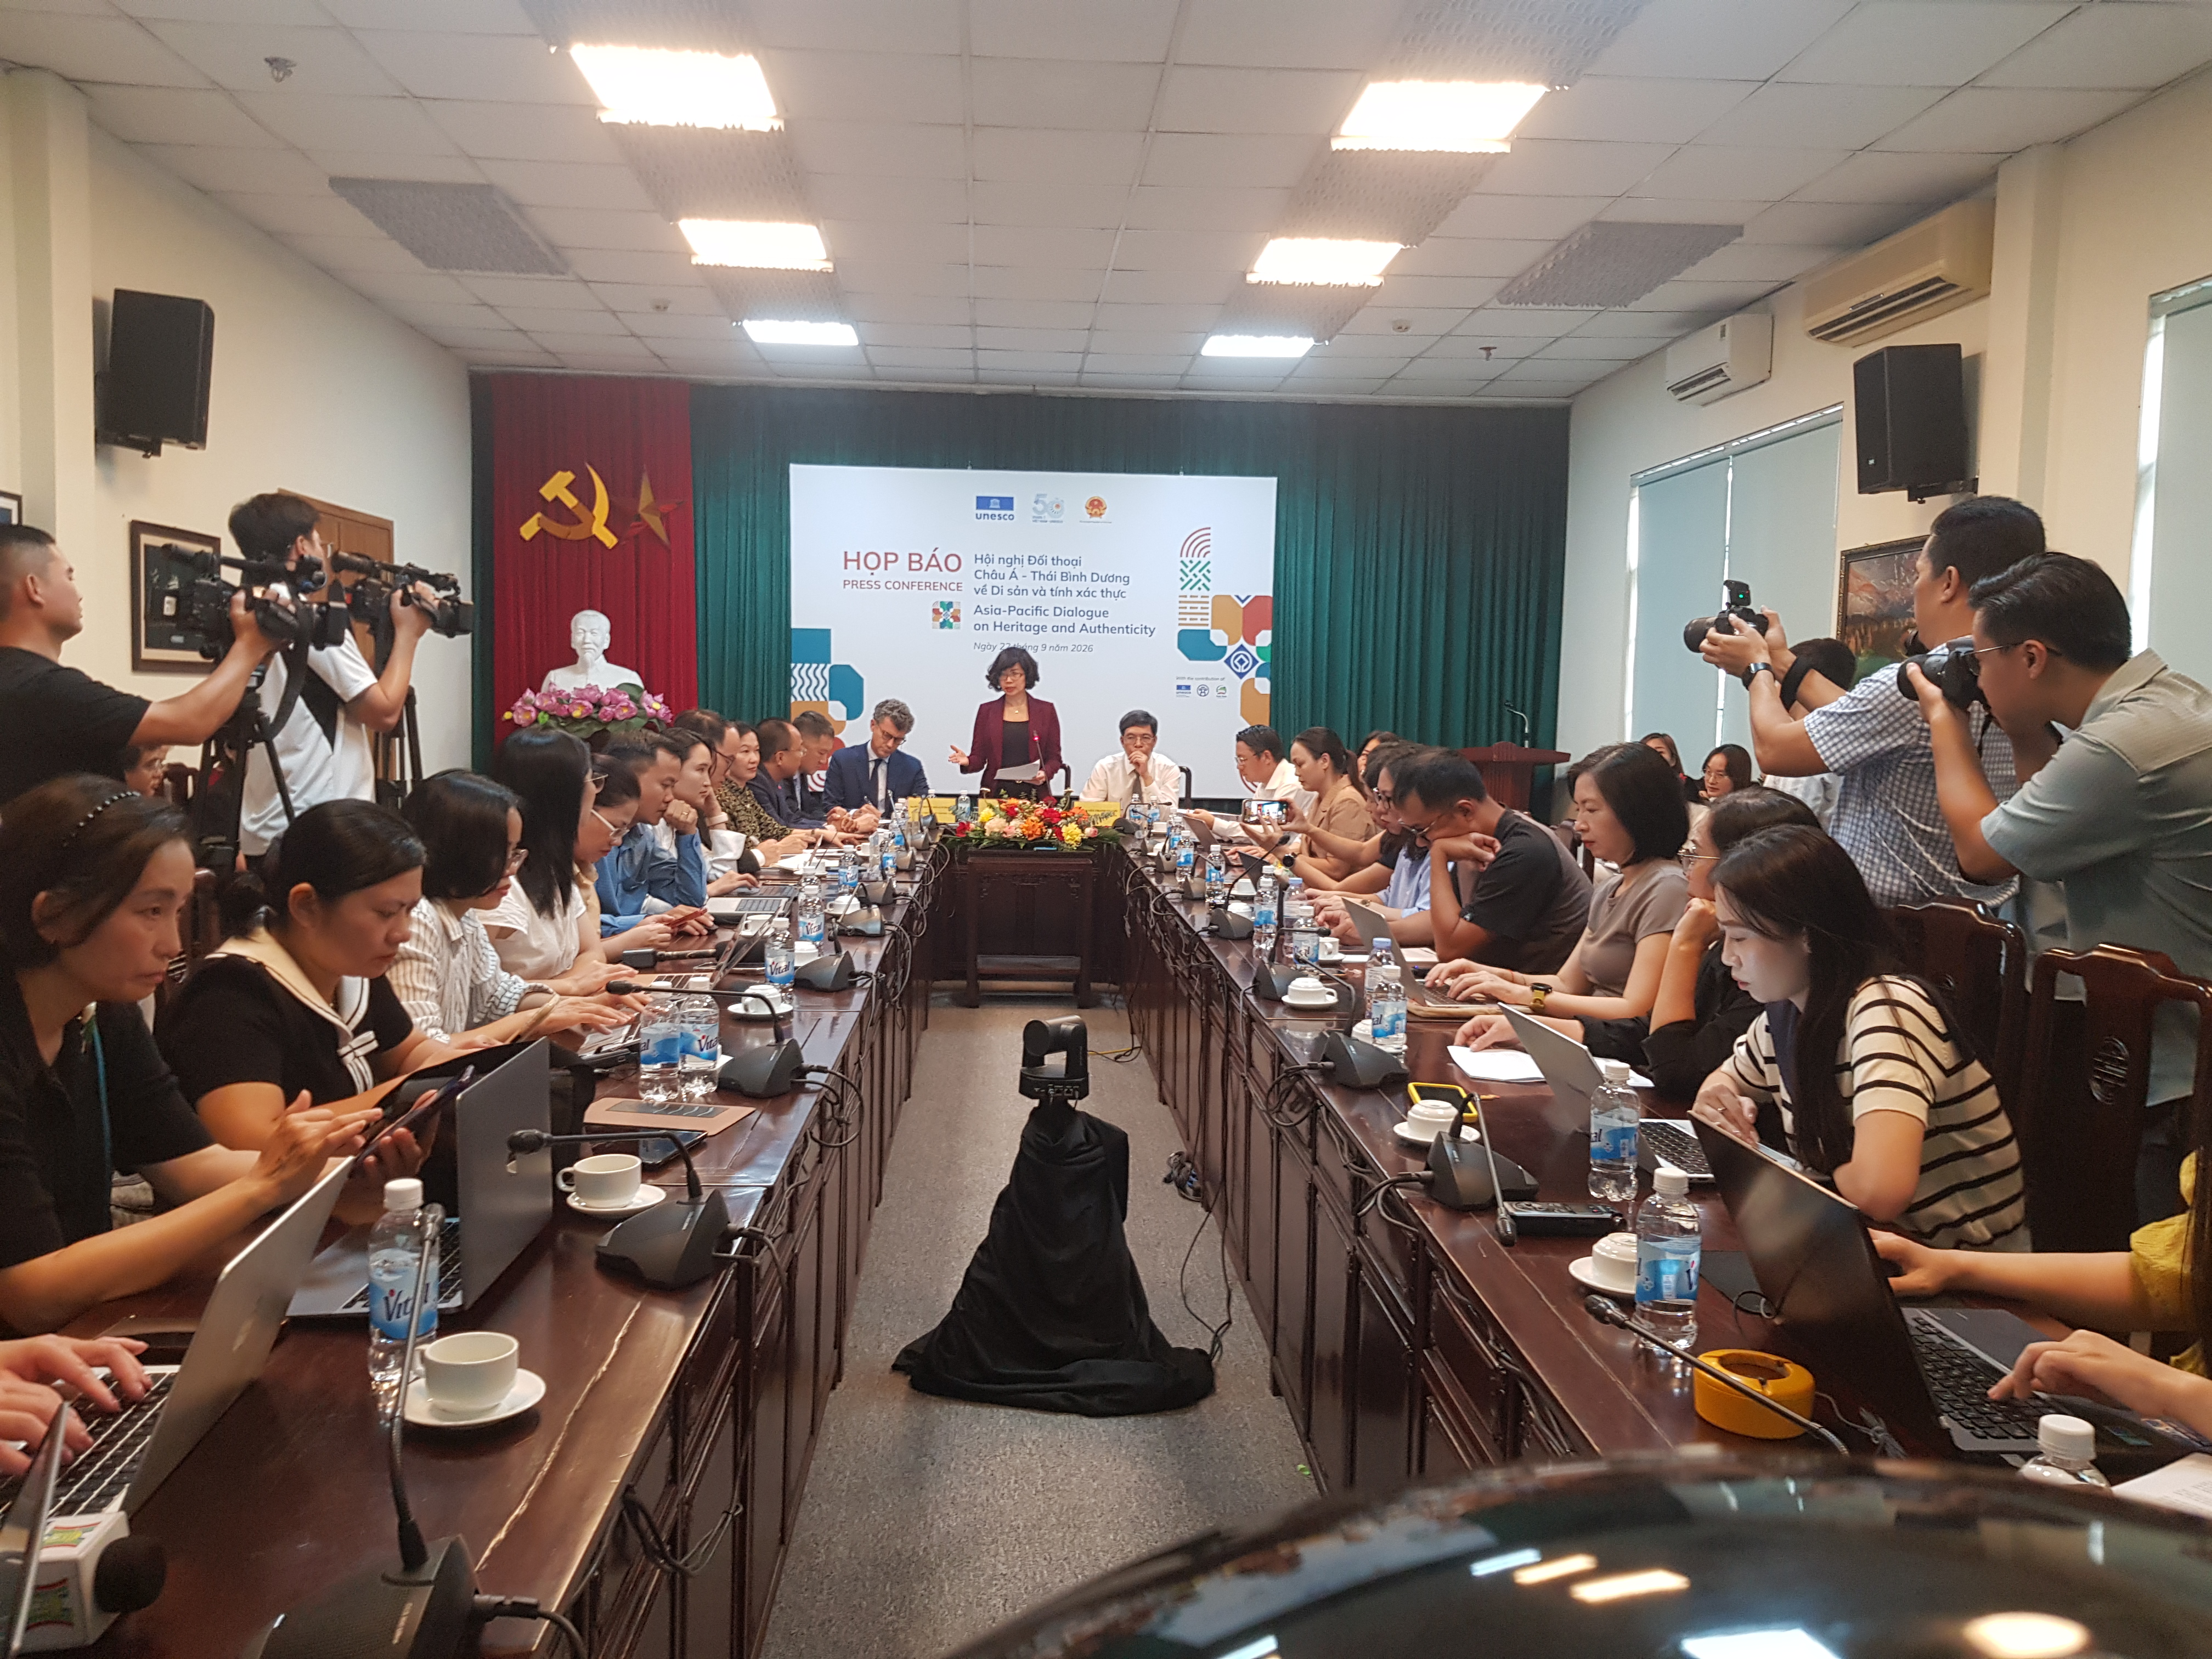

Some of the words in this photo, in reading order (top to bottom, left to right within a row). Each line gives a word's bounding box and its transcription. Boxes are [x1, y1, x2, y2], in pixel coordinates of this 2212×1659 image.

[844, 551, 899, 575] HỌP
[908, 548, 962, 572] BÁO
[974, 554, 994, 566] Hội
[998, 555, 1024, 567] nghị
[1028, 555, 1047, 566] Đối
[1051, 556, 1081, 568] thoại
[974, 569, 1005, 580] Châu
[1009, 568, 1019, 580] Á
[1030, 571, 1057, 581] Thái
[1060, 571, 1087, 582] Bình
[1091, 572, 1130, 585] Dương
[843, 579, 881, 590] PRESS
[884, 580, 963, 591] CONFERENCE
[974, 584, 988, 595] về
[991, 585, 1003, 596] Di
[1007, 585, 1028, 596] sản
[1032, 586, 1046, 596] và
[1050, 586, 1073, 597] tính
[1076, 587, 1097, 598] xác
[1101, 588, 1126, 601] thực
[973, 605, 1049, 617] Asia-Pacific
[1053, 606, 1109, 620] Dialogue
[973, 623, 988, 631] on
[993, 621, 1047, 635] Heritage
[1051, 623, 1075, 633] and
[1079, 623, 1155, 637] Authenticity
[973, 642, 997, 652] Ngày
[1071, 644, 1093, 652] 2026
[769, 961, 790, 975] Vital
[383, 1283, 430, 1322] Vitl
